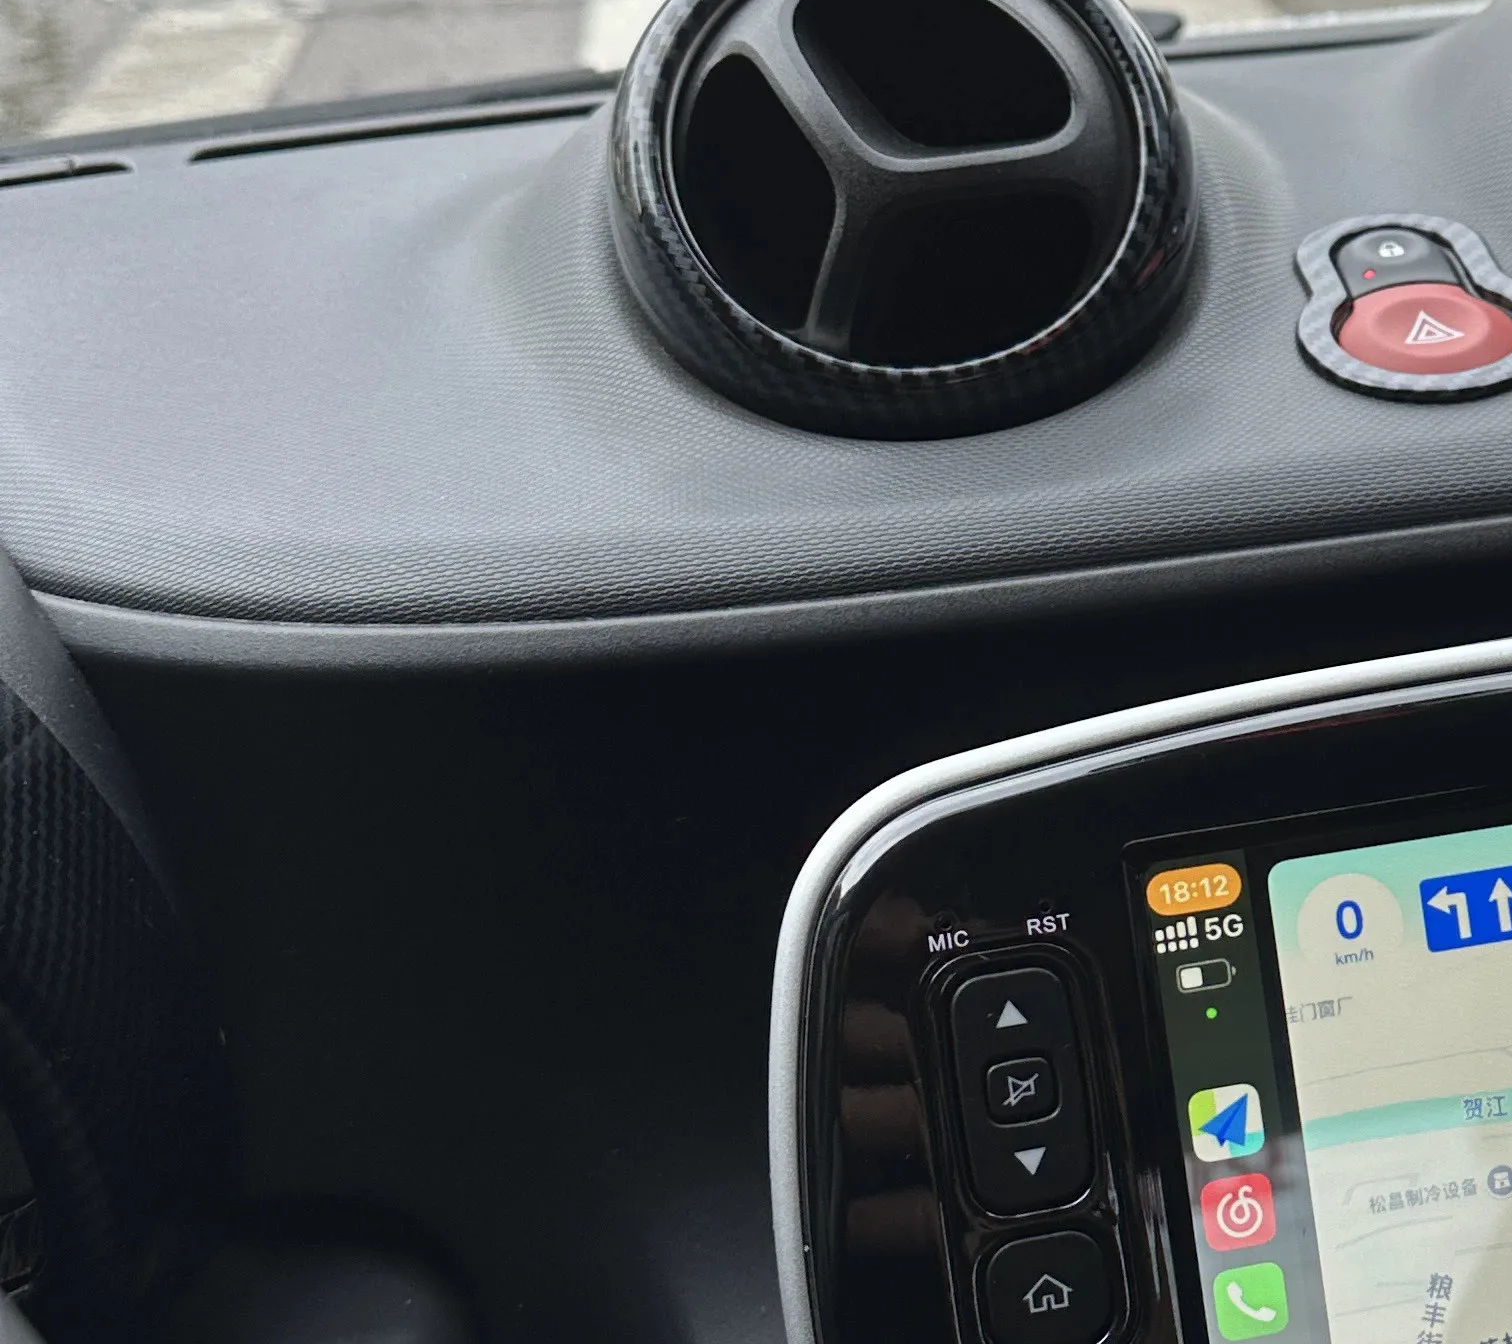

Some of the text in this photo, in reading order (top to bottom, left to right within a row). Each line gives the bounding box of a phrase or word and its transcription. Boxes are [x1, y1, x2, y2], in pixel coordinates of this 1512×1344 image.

[1158, 874, 1230, 905] 18:12
[1026, 912, 1071, 936] RST
[1204, 913, 1245, 941] 5G
[1336, 899, 1364, 940] 0
[927, 929, 971, 954] MIC
[1334, 948, 1375, 965] km/h
[1463, 1095, 1508, 1121] 贺江
